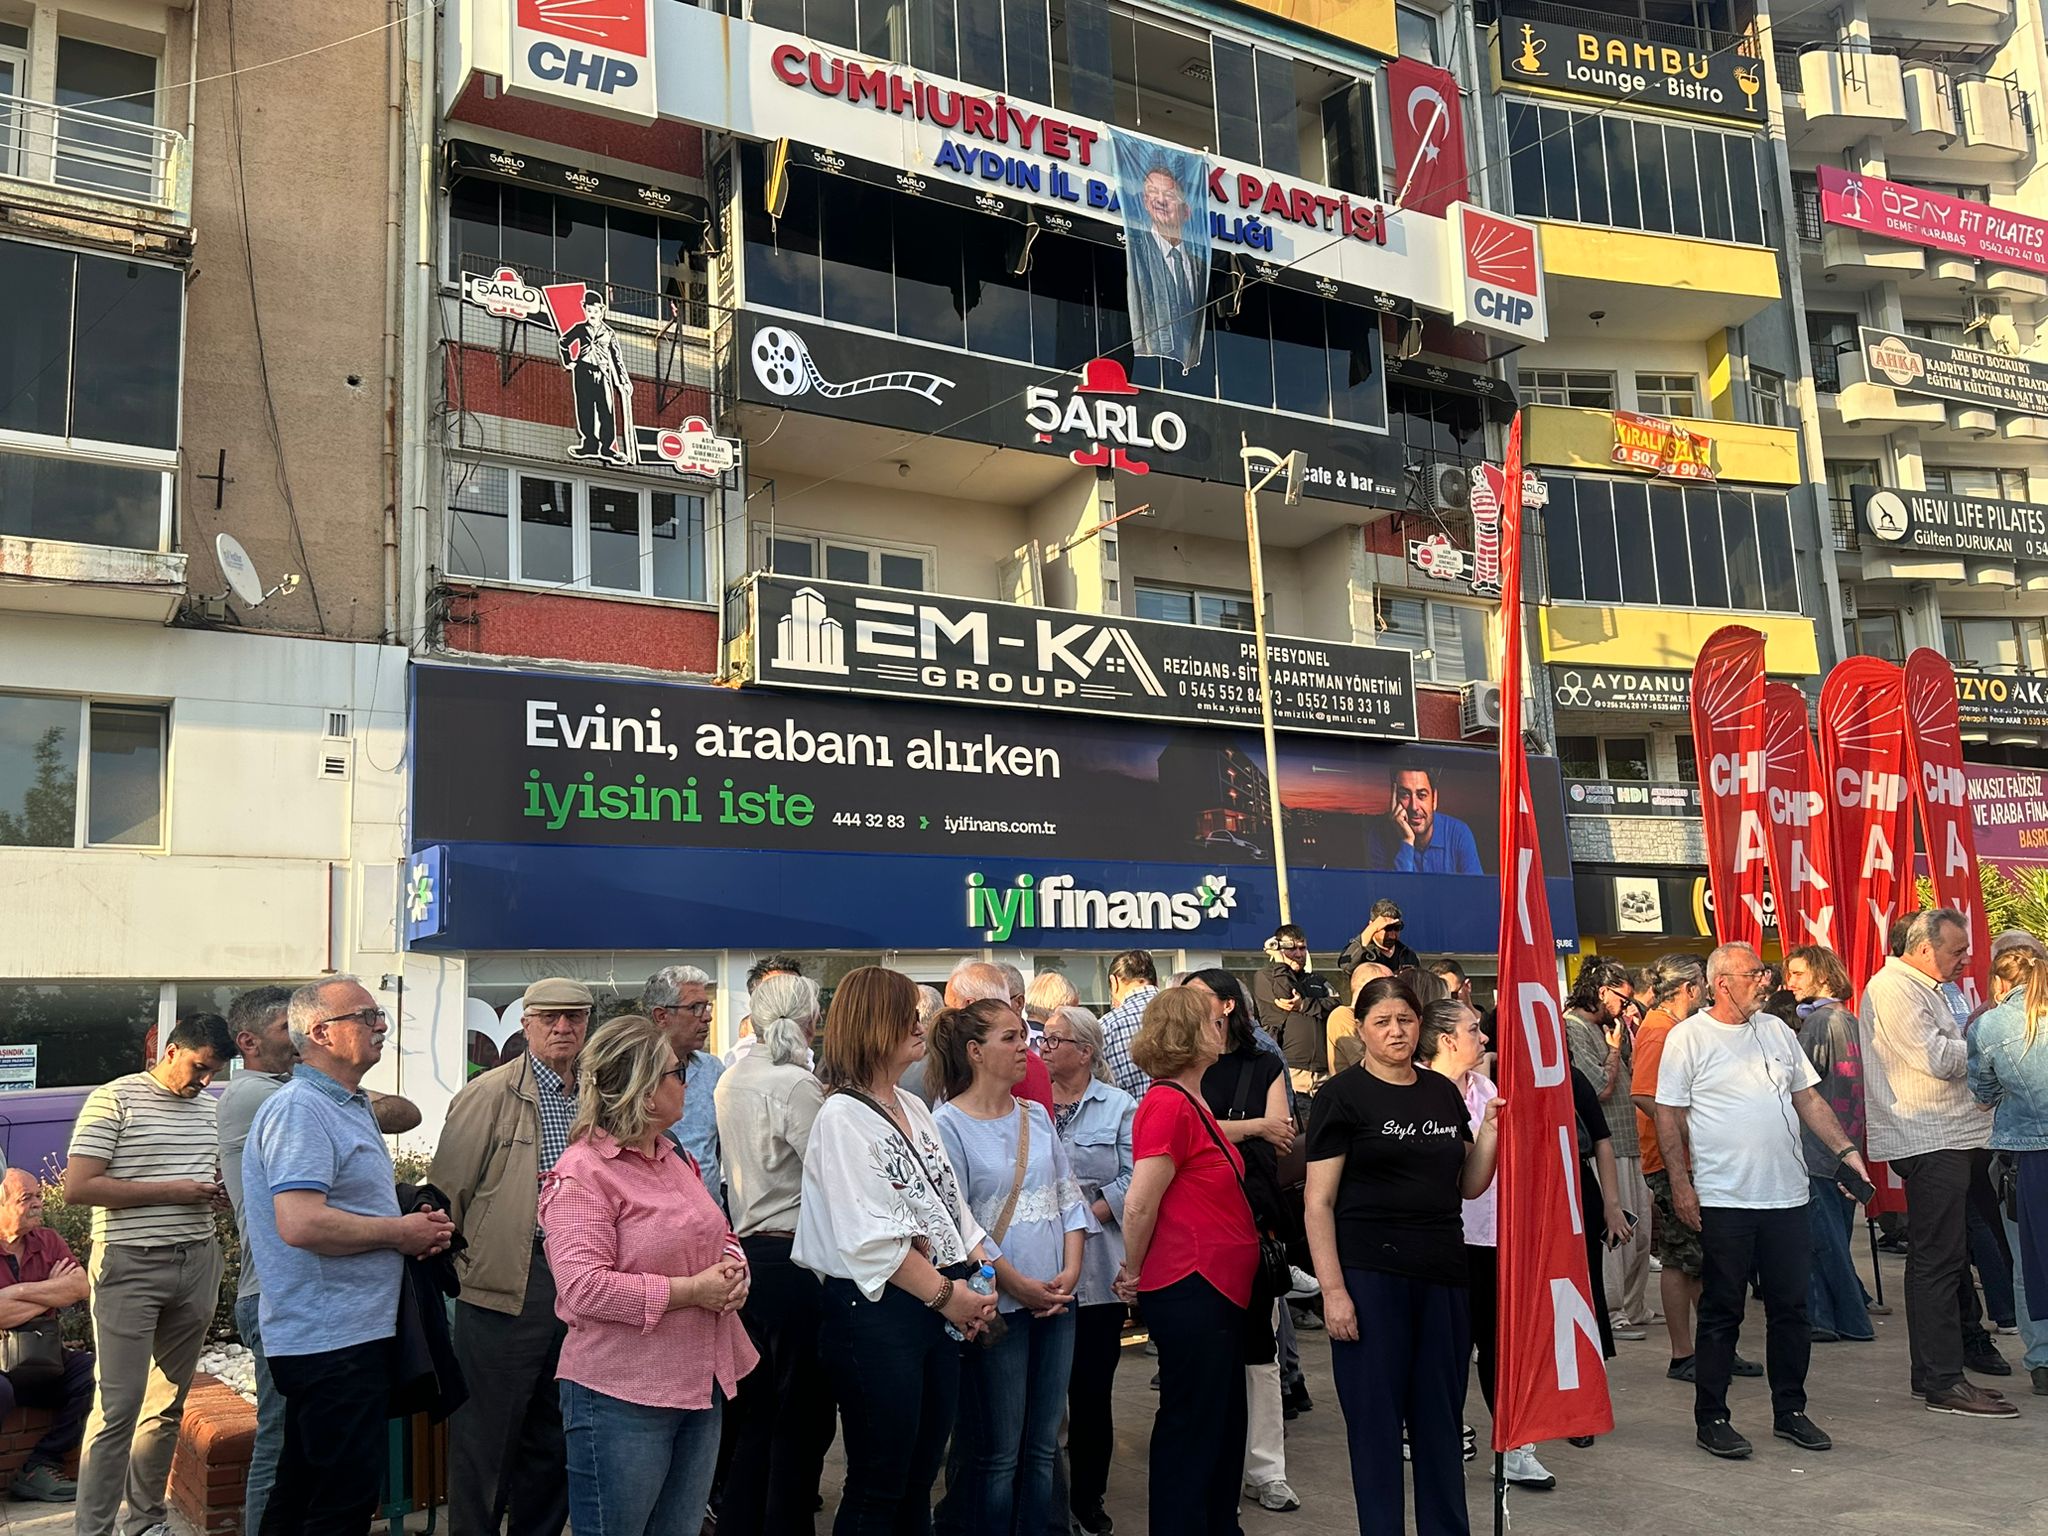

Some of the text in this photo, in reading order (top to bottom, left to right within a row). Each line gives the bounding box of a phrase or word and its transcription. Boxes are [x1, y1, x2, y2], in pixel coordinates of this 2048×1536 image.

[528, 42, 638, 94] CHP
[1577, 33, 1708, 80] BAMBU
[1566, 60, 1646, 93] Lounge
[1668, 77, 1724, 104] Bistro
[771, 44, 1387, 246] CUMHURİYET PARTİSİ
[933, 140, 1041, 192] AYDIN
[1049, 162, 1080, 202] İL
[1882, 186, 1951, 225] ÖZAY
[1979, 239, 2046, 264] 0542 472 47 01
[1474, 287, 1534, 326] CHP
[1876, 351, 1920, 373] AHKA
[1926, 358, 1970, 378] KADRİYE
[1972, 366, 2016, 386] BOZKURT
[1951, 349, 2030, 374] AHMET BOZKURT
[1926, 373, 1962, 391] EĞİTİM
[1964, 379, 2002, 398] KÜLTÜR
[2004, 388, 2033, 404] SANAT
[1617, 447, 1627, 460] 0
[1631, 449, 1658, 465] 507
[1681, 462, 1698, 477] 90
[1336, 470, 1347, 488] &
[1351, 472, 1374, 492] bar
[1911, 497, 2046, 535] NEW LIFE PILATES
[1914, 529, 1952, 548] Gülten
[1956, 533, 2012, 553] DURUKAN
[2026, 540, 2033, 554] 0
[1240, 643, 1330, 667] PRFESYONEL
[921, 666, 1076, 698] GROUP
[1163, 656, 1230, 679] REZİDANS
[1274, 669, 1343, 690] APARTMAN
[1346, 674, 1402, 696] YÖNETİMİ
[1179, 681, 1186, 696] 0
[1191, 682, 1215, 698] 545
[1219, 684, 1243, 701] 552
[1297, 692, 1328, 710] 0552
[1331, 695, 1354, 712] 158
[1357, 697, 1373, 714] 33
[1376, 699, 1391, 715] 18
[525, 699, 1061, 780] Evini, arabanı alırken
[523, 768, 1057, 835] iyisini iste 444 32 83 iyifinans.com.tr
[1616, 787, 1649, 803] HDI
[1836, 767, 1908, 812] CHP
[2006, 772, 2044, 798] FAİZSİZ
[1768, 786, 1824, 827] CHP
[1973, 804, 1989, 826] VE
[1990, 801, 2025, 825] ARABA
[966, 872, 1202, 942] iyifinans
[1381, 1120, 1417, 1140] Style
